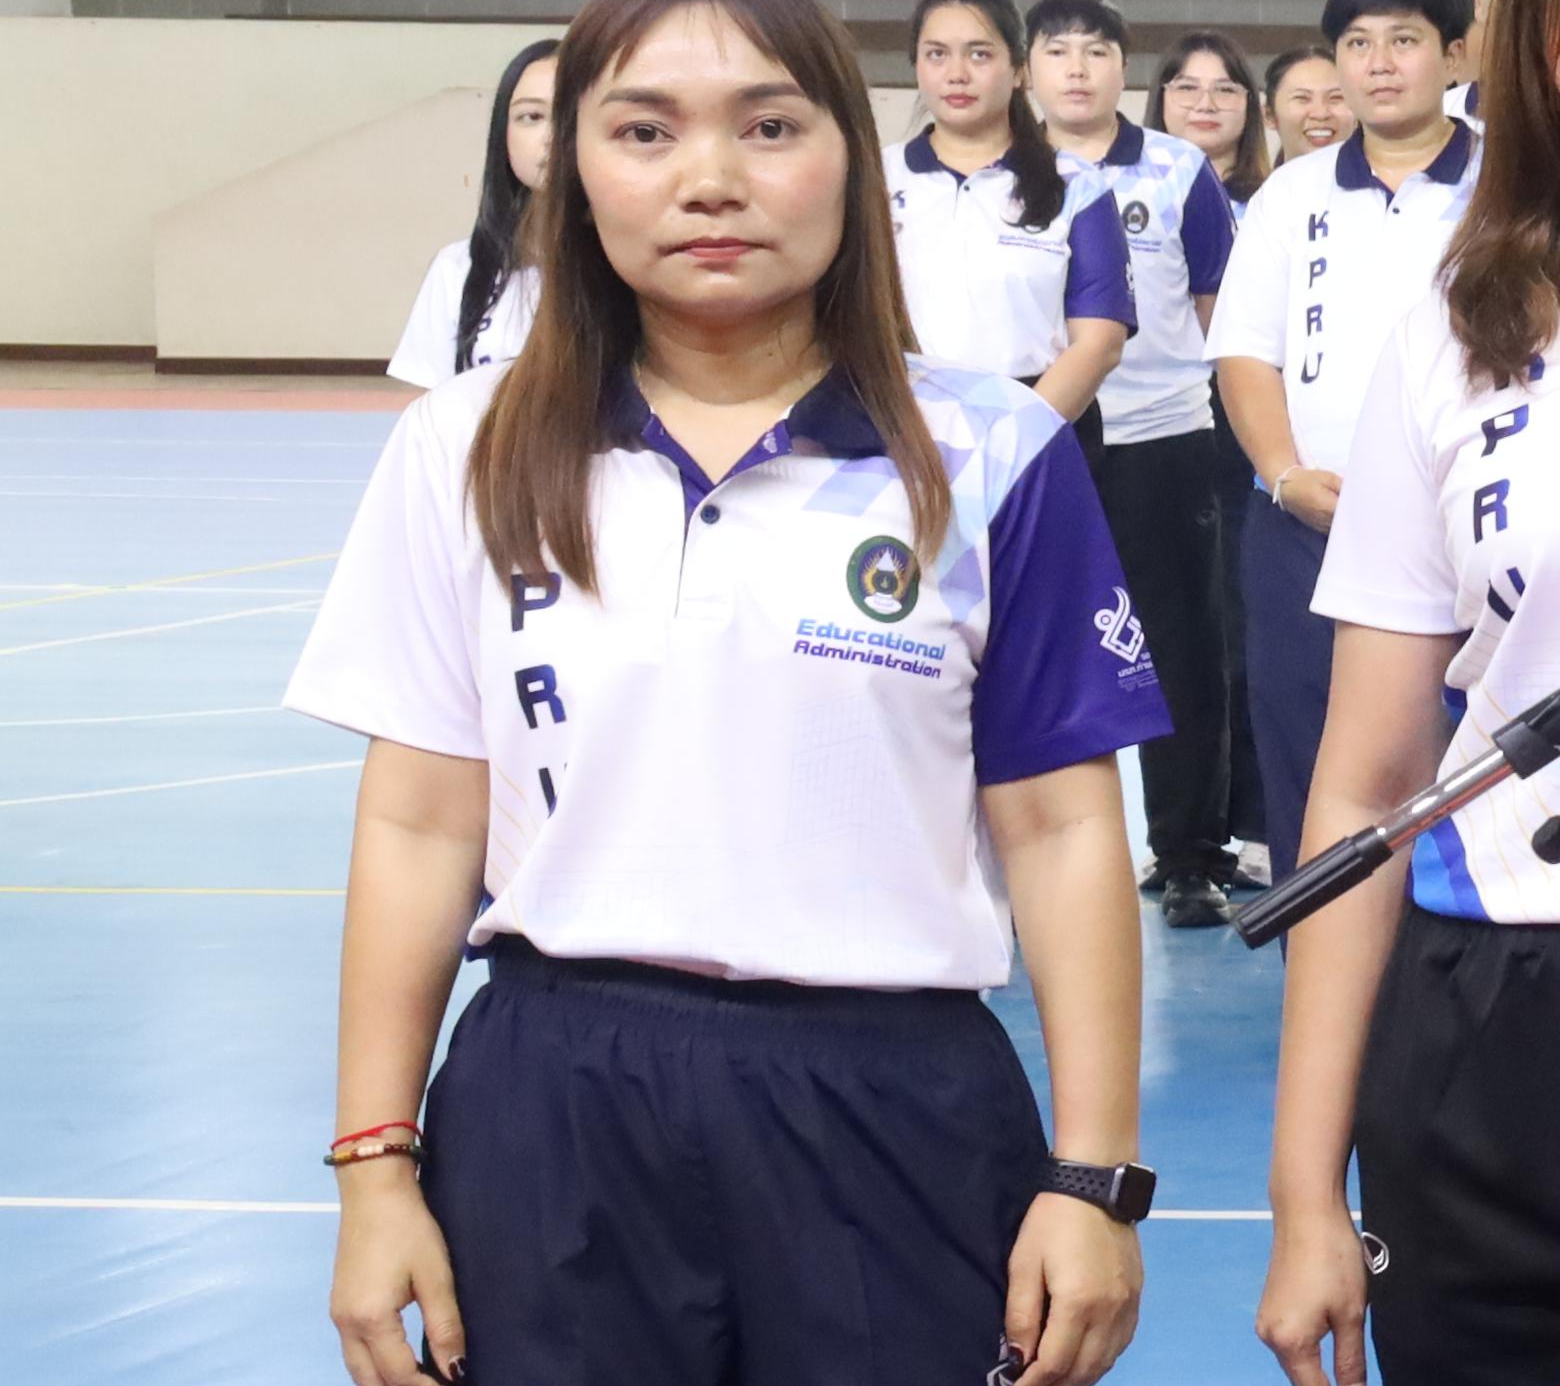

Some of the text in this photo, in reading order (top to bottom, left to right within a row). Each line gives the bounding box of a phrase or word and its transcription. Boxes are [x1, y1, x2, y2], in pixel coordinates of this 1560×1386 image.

[1300, 211, 1328, 384] KPRU
[794, 640, 942, 679] Administration
[796, 618, 946, 661] Educational
